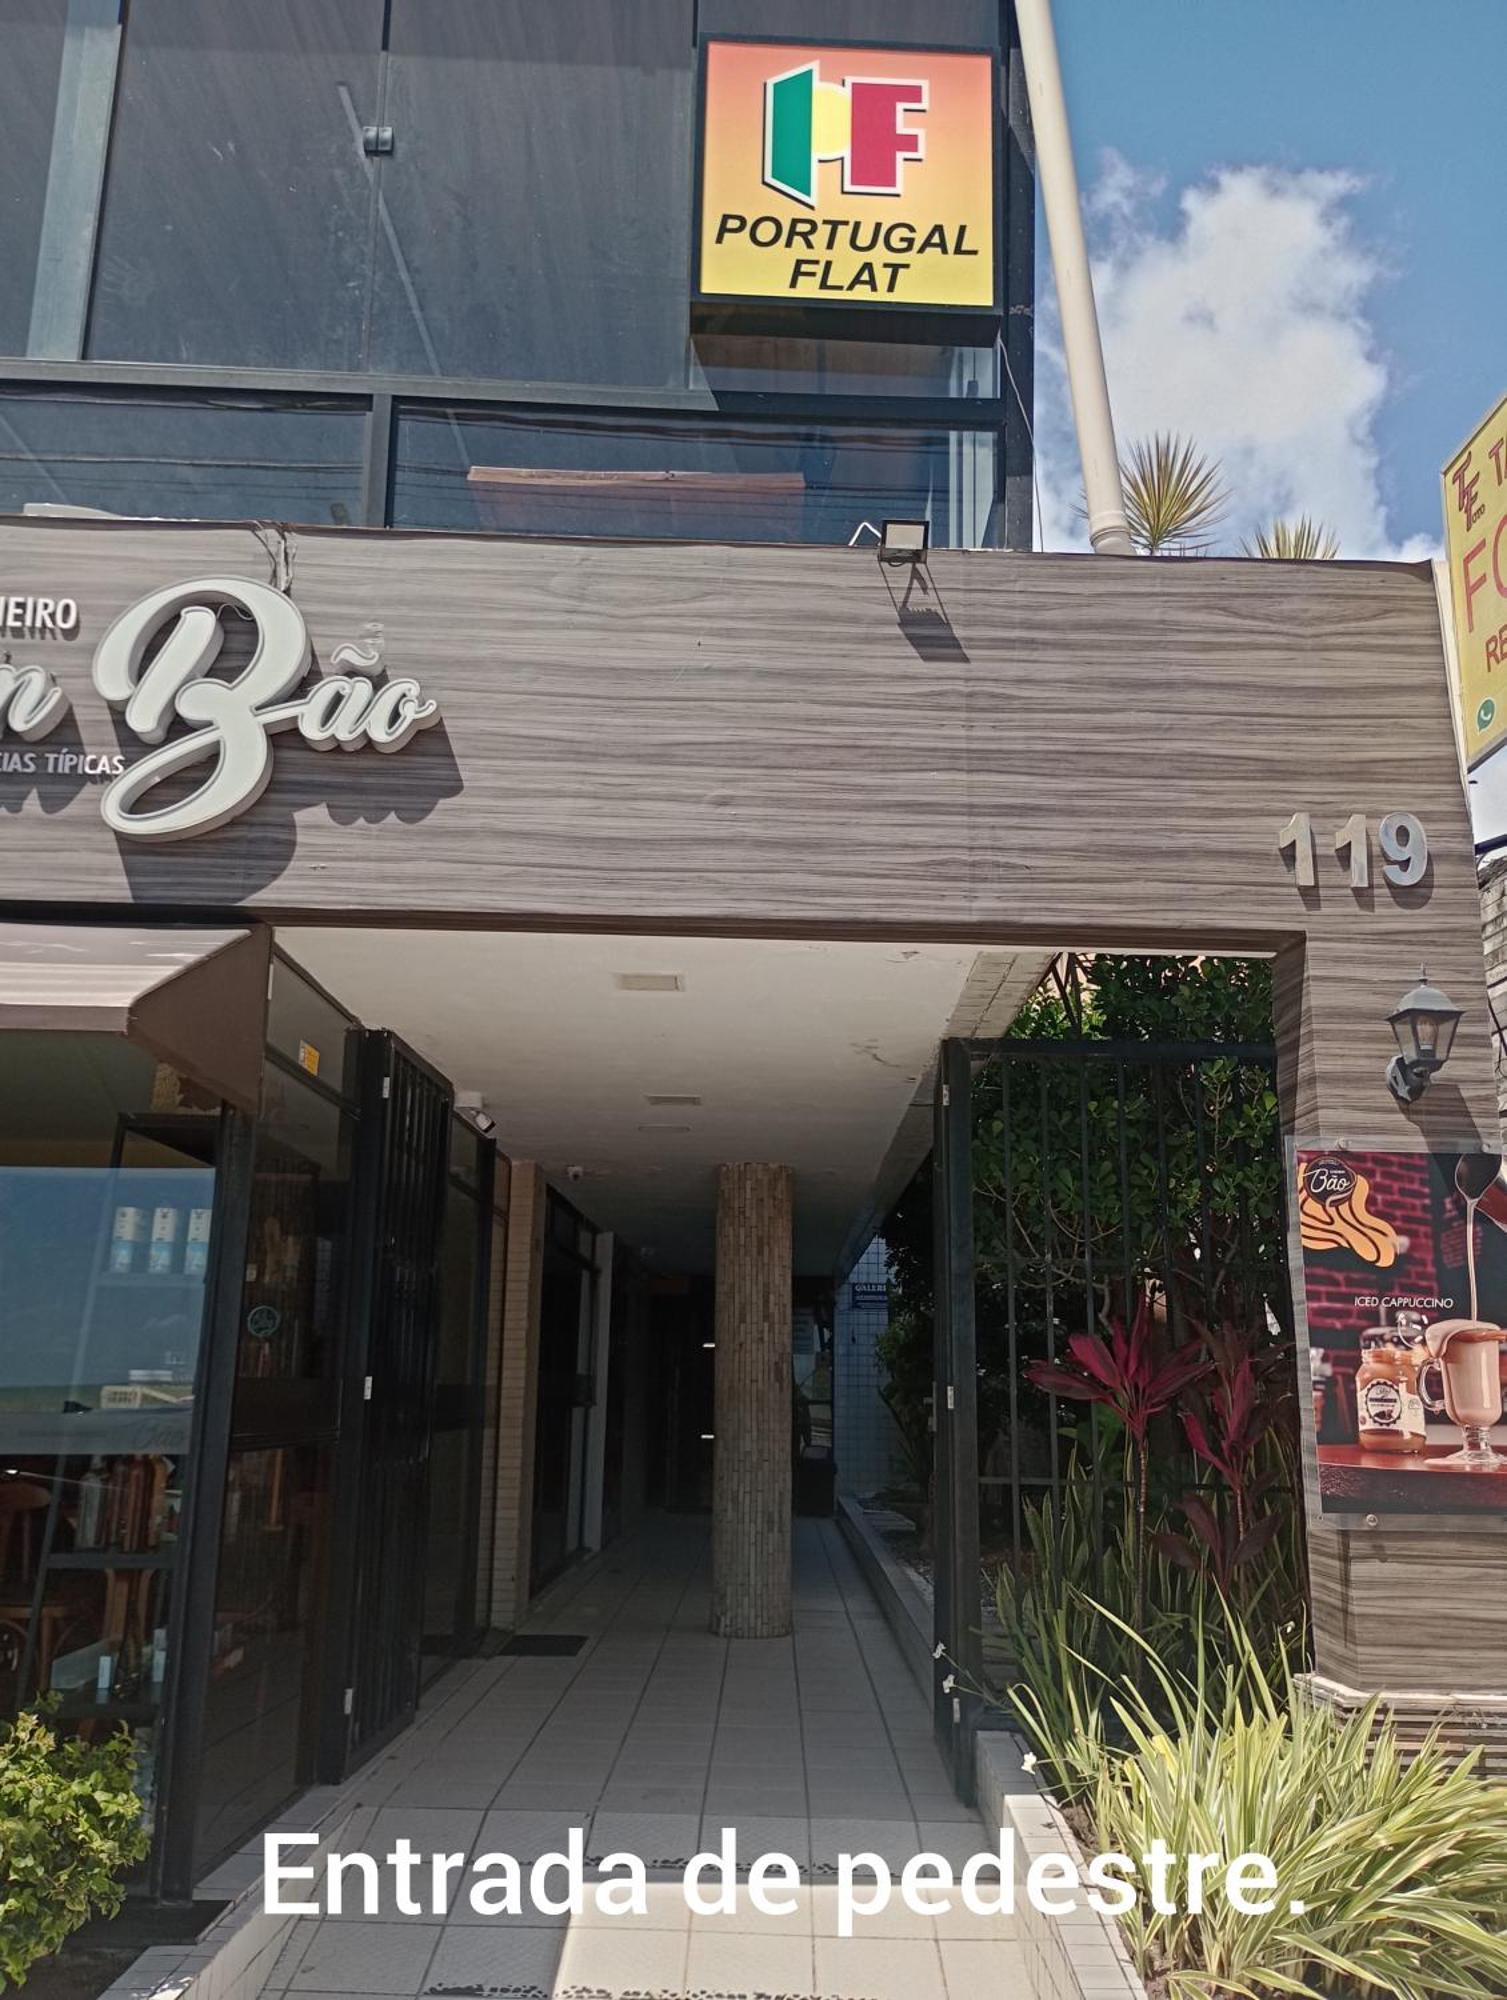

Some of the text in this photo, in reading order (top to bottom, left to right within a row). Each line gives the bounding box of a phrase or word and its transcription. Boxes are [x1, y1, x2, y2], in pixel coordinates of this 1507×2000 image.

[715, 213, 979, 256] PORTUGAL
[789, 258, 910, 293] FLAT
[0, 596, 77, 630] EIRO
[93, 574, 440, 838] Bão
[0, 747, 126, 775] IAS TÍPICAS
[1279, 811, 1428, 888] 119
[1303, 1168, 1351, 1193] Bão
[1354, 1296, 1454, 1309] ICED CAPPUCCINO
